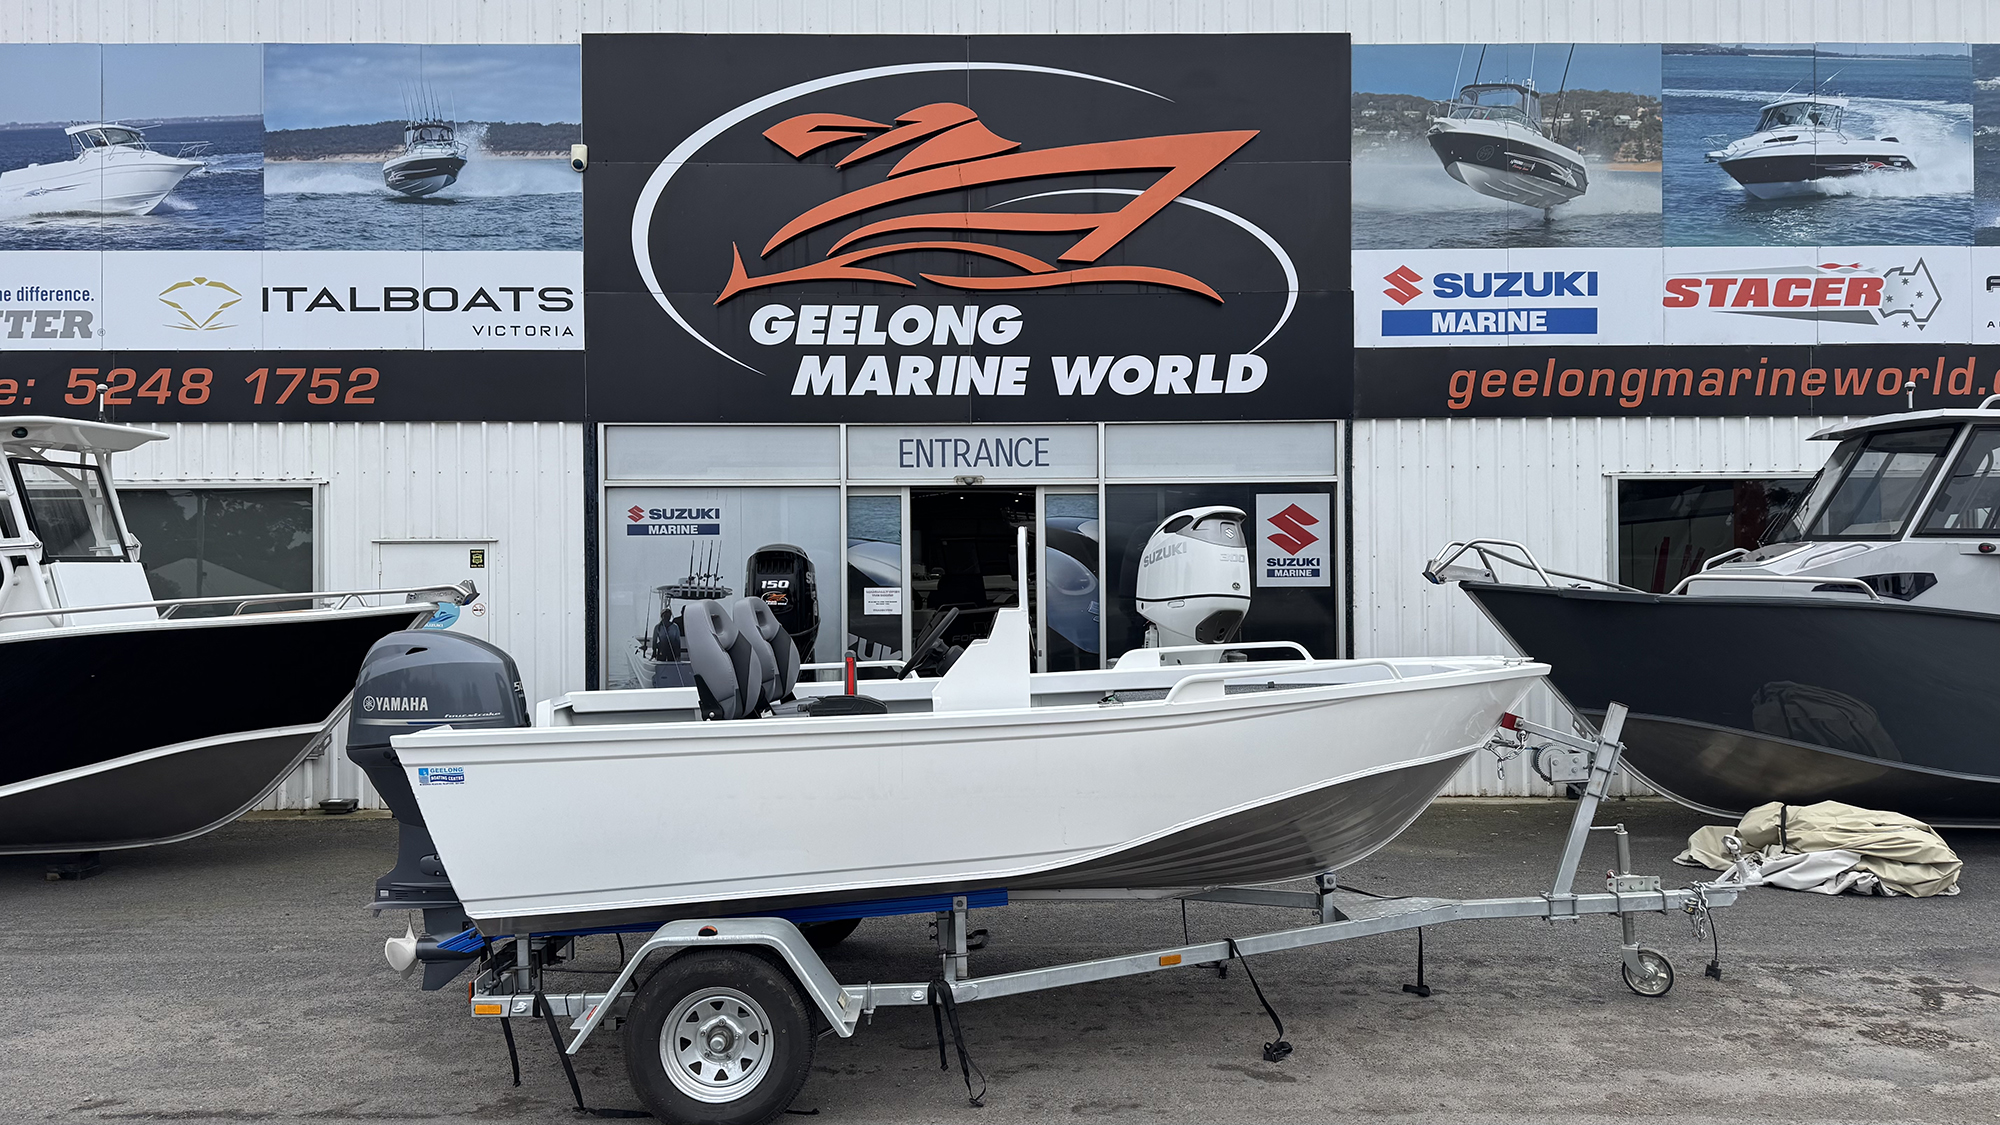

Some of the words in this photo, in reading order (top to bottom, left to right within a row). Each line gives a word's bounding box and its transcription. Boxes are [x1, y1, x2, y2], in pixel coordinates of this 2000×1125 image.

[0, 286, 12, 301] e
[17, 286, 95, 302] difference.
[1432, 271, 1599, 299] SUZUKI
[1663, 277, 1884, 308] STACER
[262, 286, 574, 313] ITALBOATS
[0, 310, 94, 339] TER
[472, 325, 574, 337] VICTORIA
[749, 303, 1024, 346] GEELONG
[1431, 310, 1548, 333] MARINE
[790, 355, 1030, 396] MARINE
[1052, 353, 1268, 396] WORLD
[1447, 356, 2000, 410] geelongmarineworld.
[64, 368, 214, 406] 5248
[245, 368, 379, 406] 1752
[899, 437, 1050, 468] ENTRANCE
[648, 507, 721, 520] SUZUKI
[648, 525, 699, 535] MARINE
[1142, 541, 1188, 568] SUZUKI
[1219, 553, 1246, 564] 300
[1266, 557, 1321, 567] SUZUKI
[761, 580, 790, 589] 150
[1274, 568, 1313, 578] MARINE
[375, 696, 429, 711] YAMAHA
[430, 766, 464, 774] GEELONG
